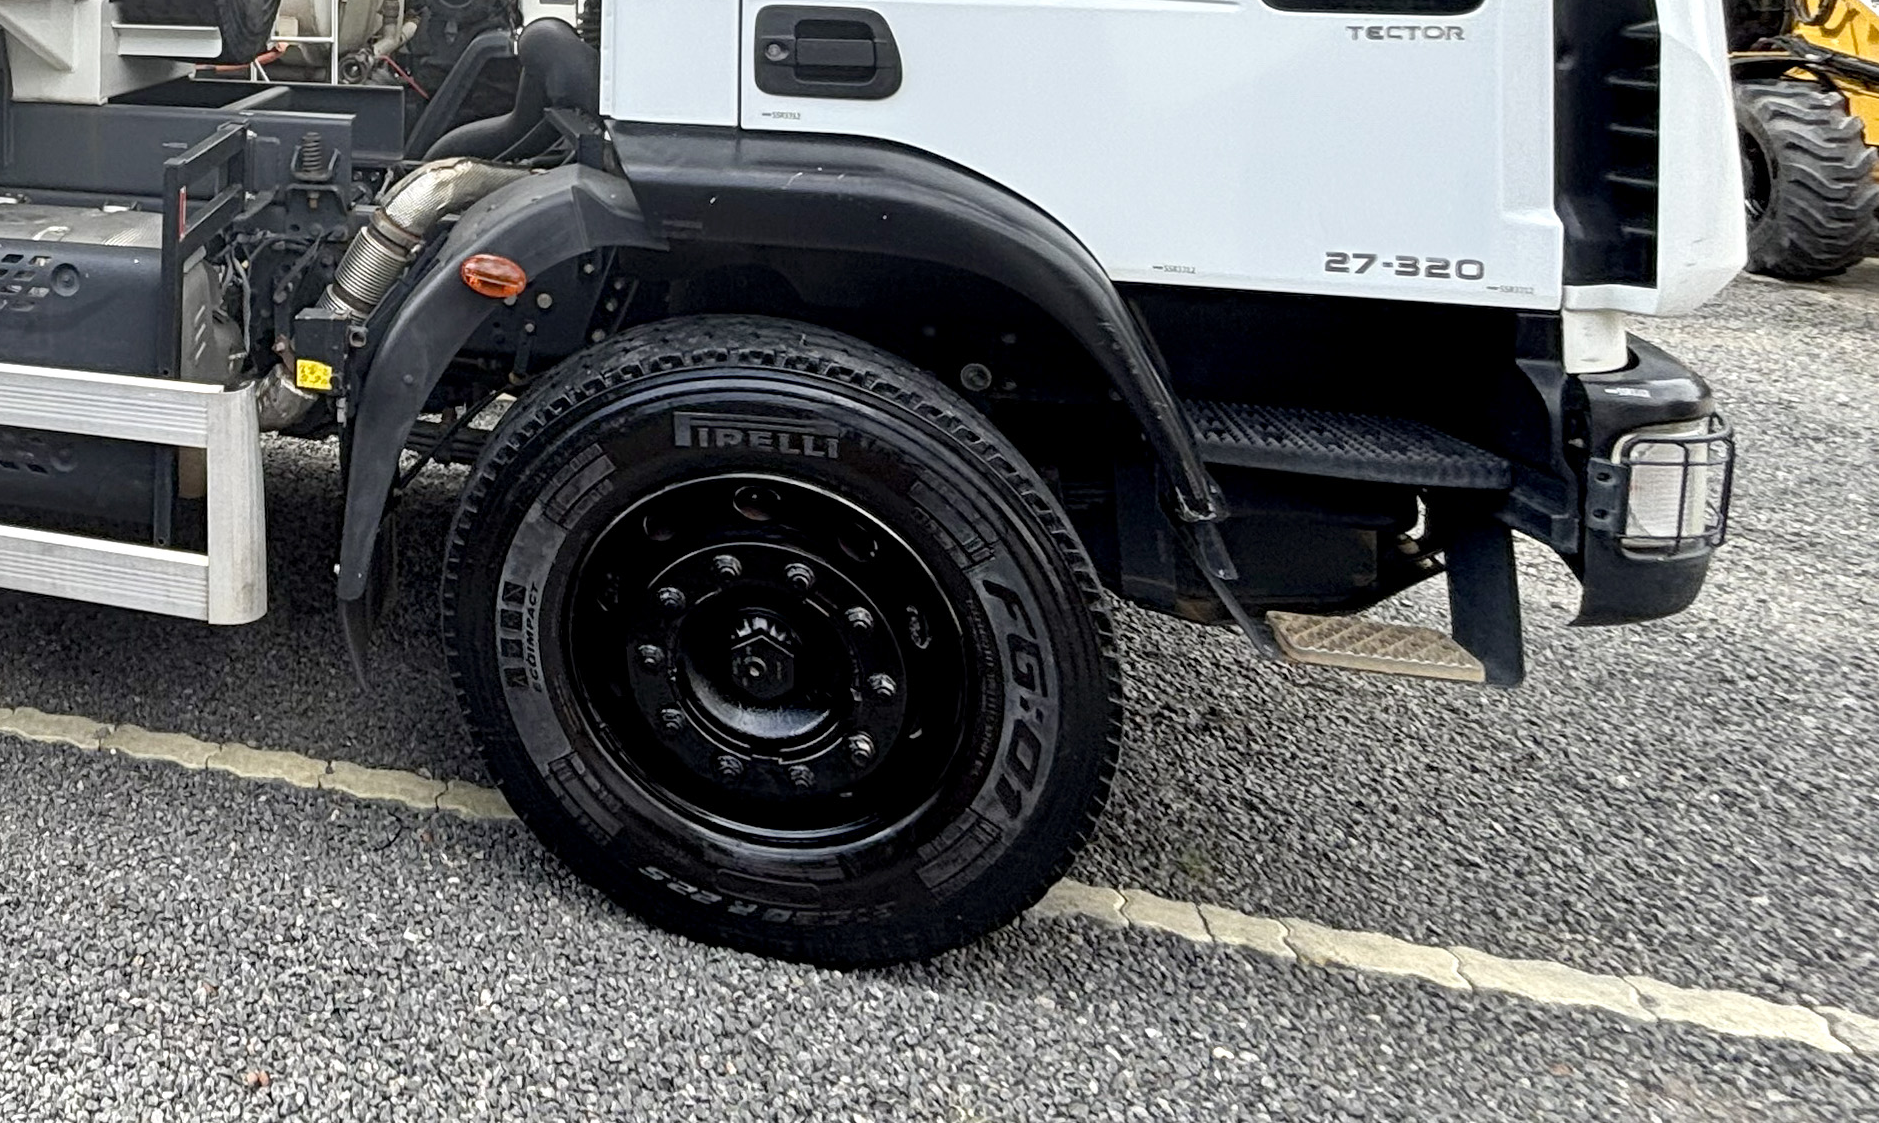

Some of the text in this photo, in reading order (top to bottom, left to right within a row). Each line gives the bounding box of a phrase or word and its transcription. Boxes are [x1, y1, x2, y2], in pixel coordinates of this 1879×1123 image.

[1346, 26, 1465, 41] TECTOR
[1324, 251, 1485, 281] 27-320
[674, 411, 840, 458] PIRELLI
